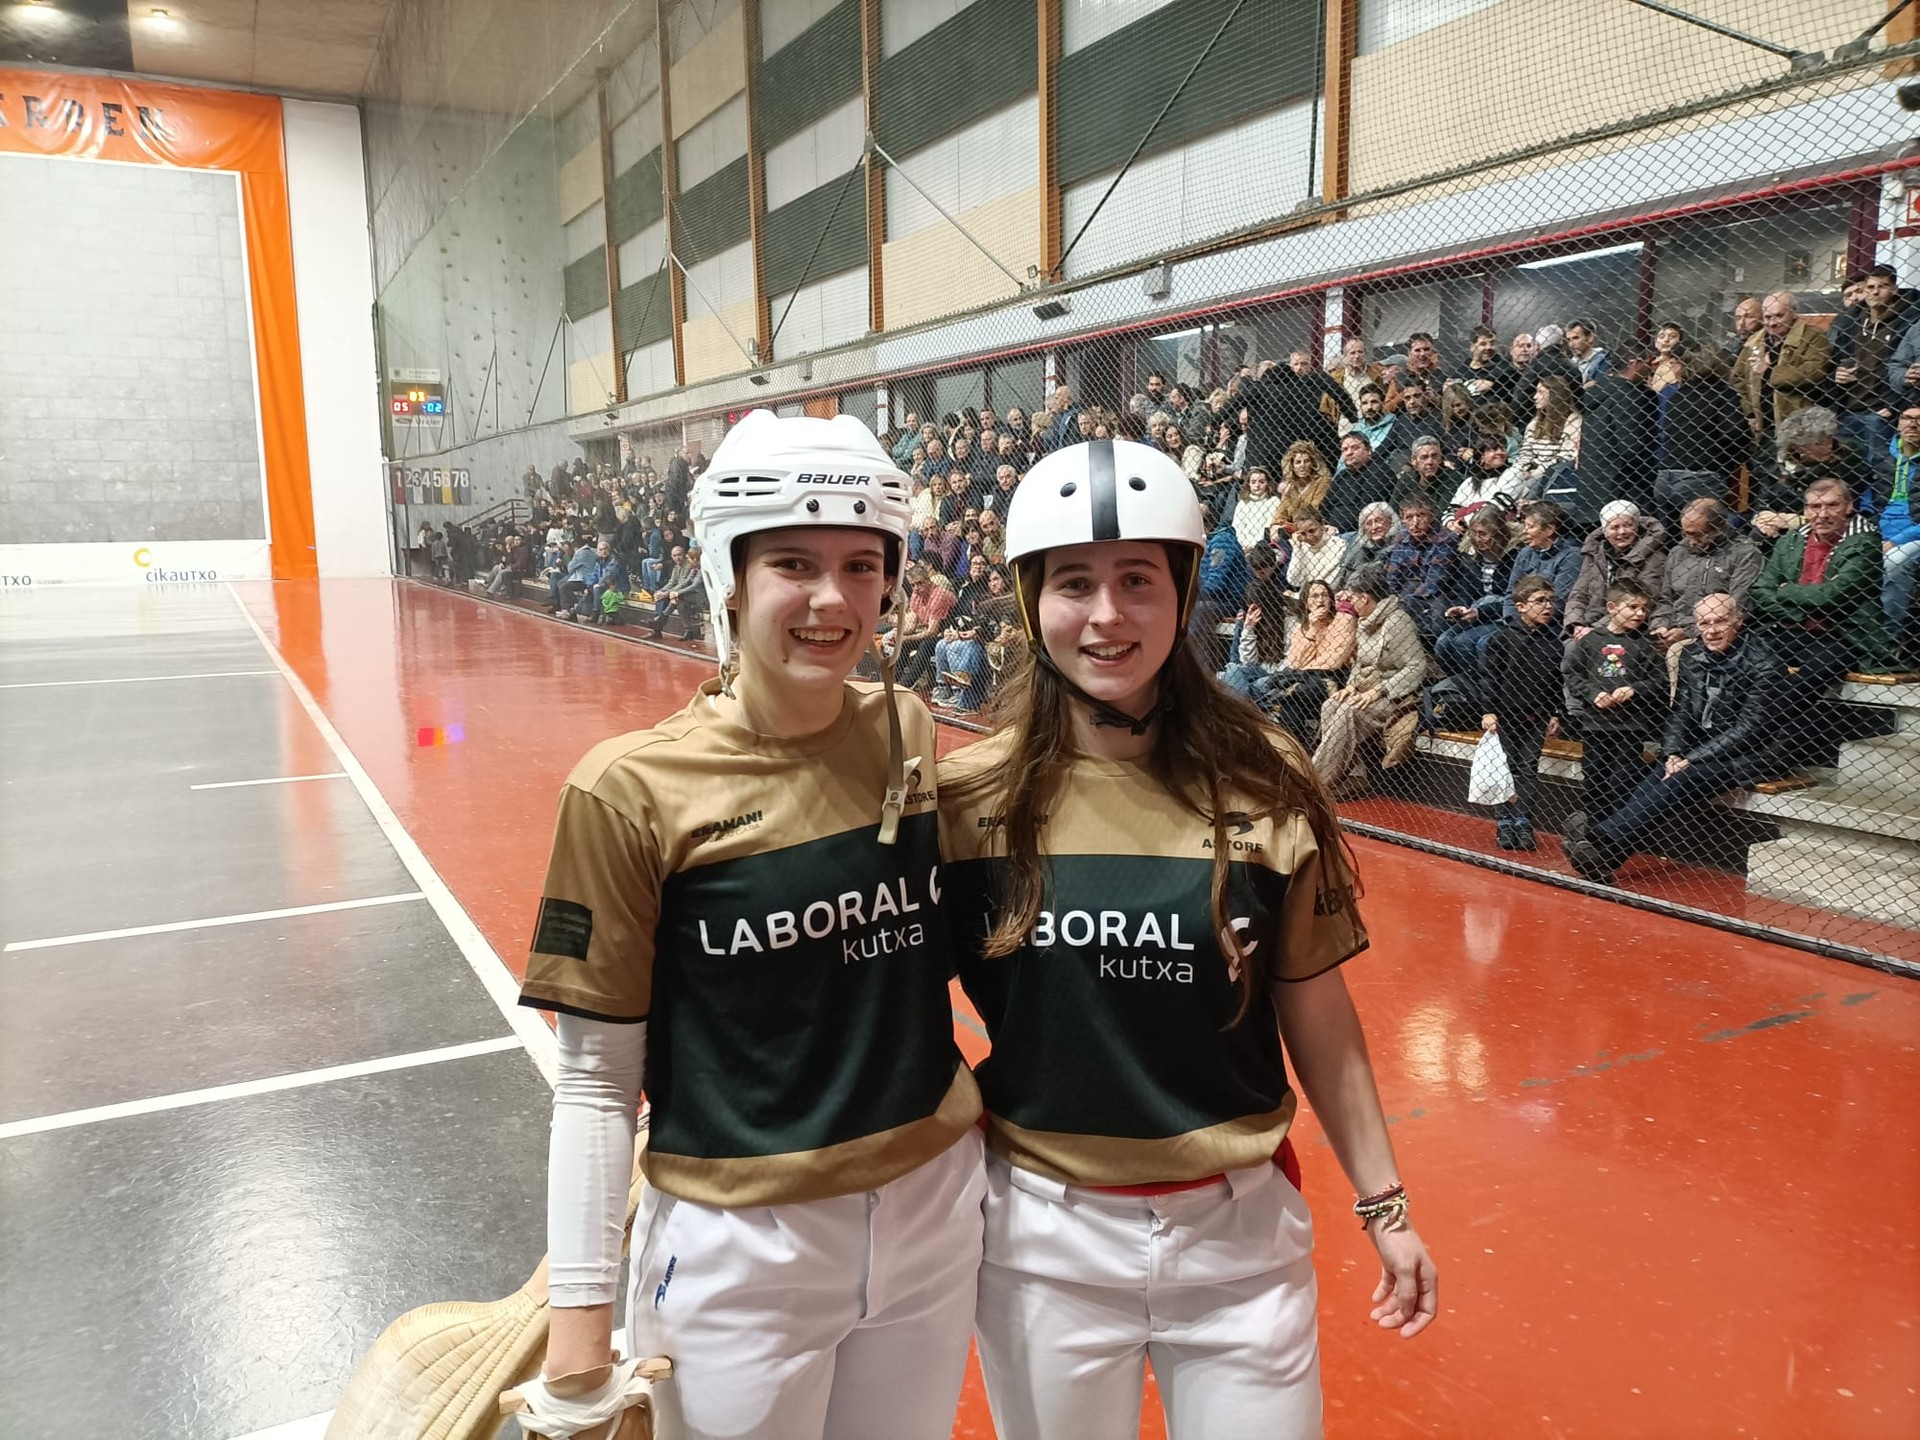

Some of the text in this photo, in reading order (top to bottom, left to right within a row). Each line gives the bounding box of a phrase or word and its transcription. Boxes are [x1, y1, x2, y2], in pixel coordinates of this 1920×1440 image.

[904, 790, 936, 805] STORE
[699, 876, 921, 957] LABORAL
[842, 922, 925, 964] kutxa
[1100, 953, 1194, 985] kutxa
